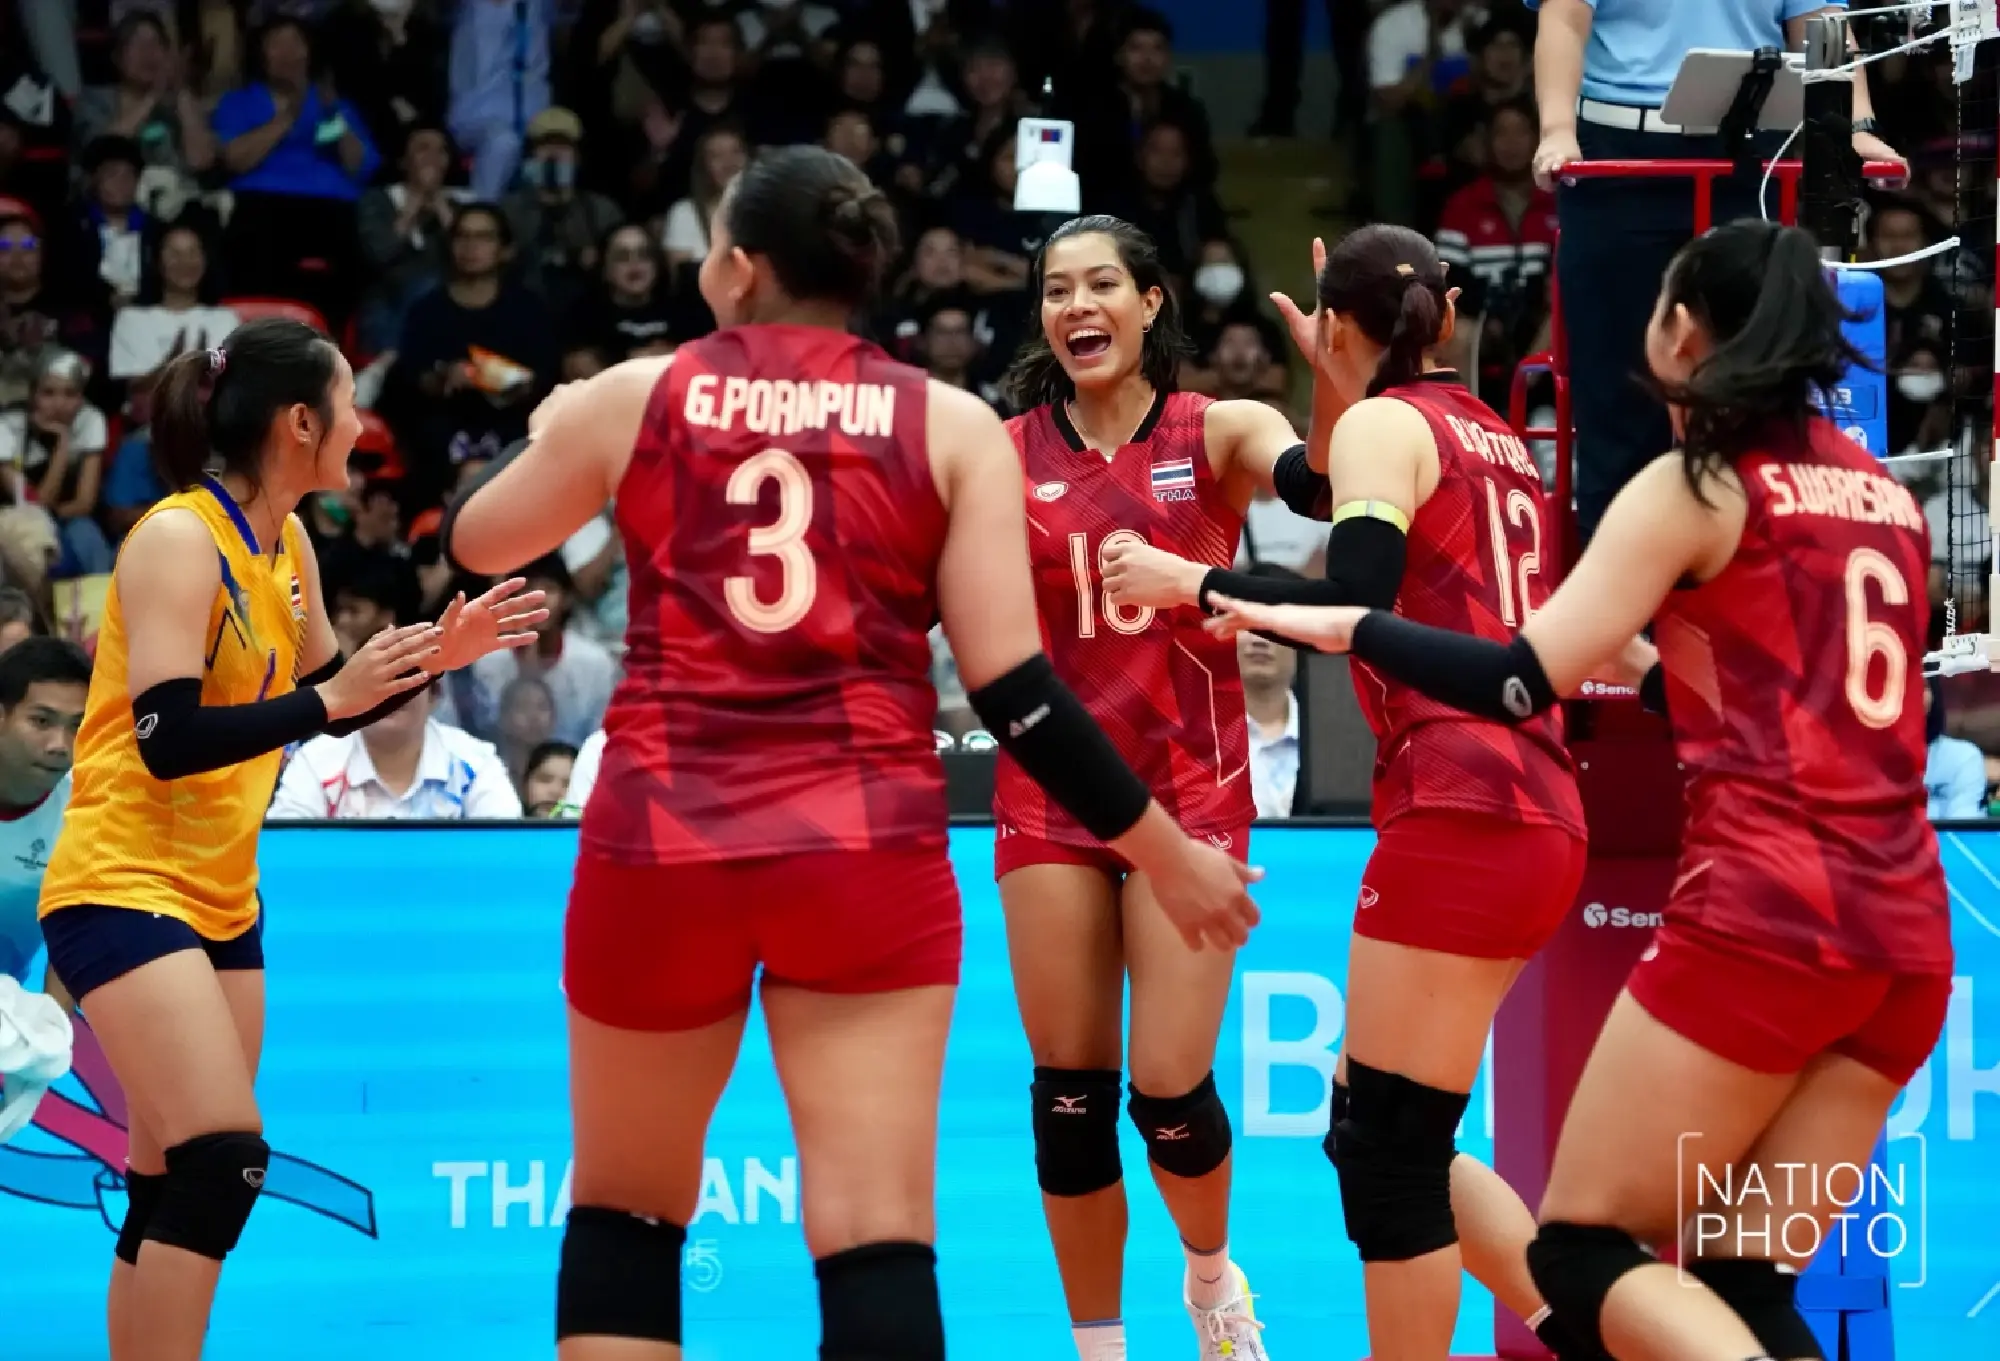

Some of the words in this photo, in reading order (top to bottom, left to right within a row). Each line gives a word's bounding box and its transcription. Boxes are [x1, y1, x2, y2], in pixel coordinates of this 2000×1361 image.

[723, 447, 818, 634] 3
[1152, 488, 1196, 503] THA
[1484, 475, 1541, 628] 12
[1844, 545, 1909, 731] 6
